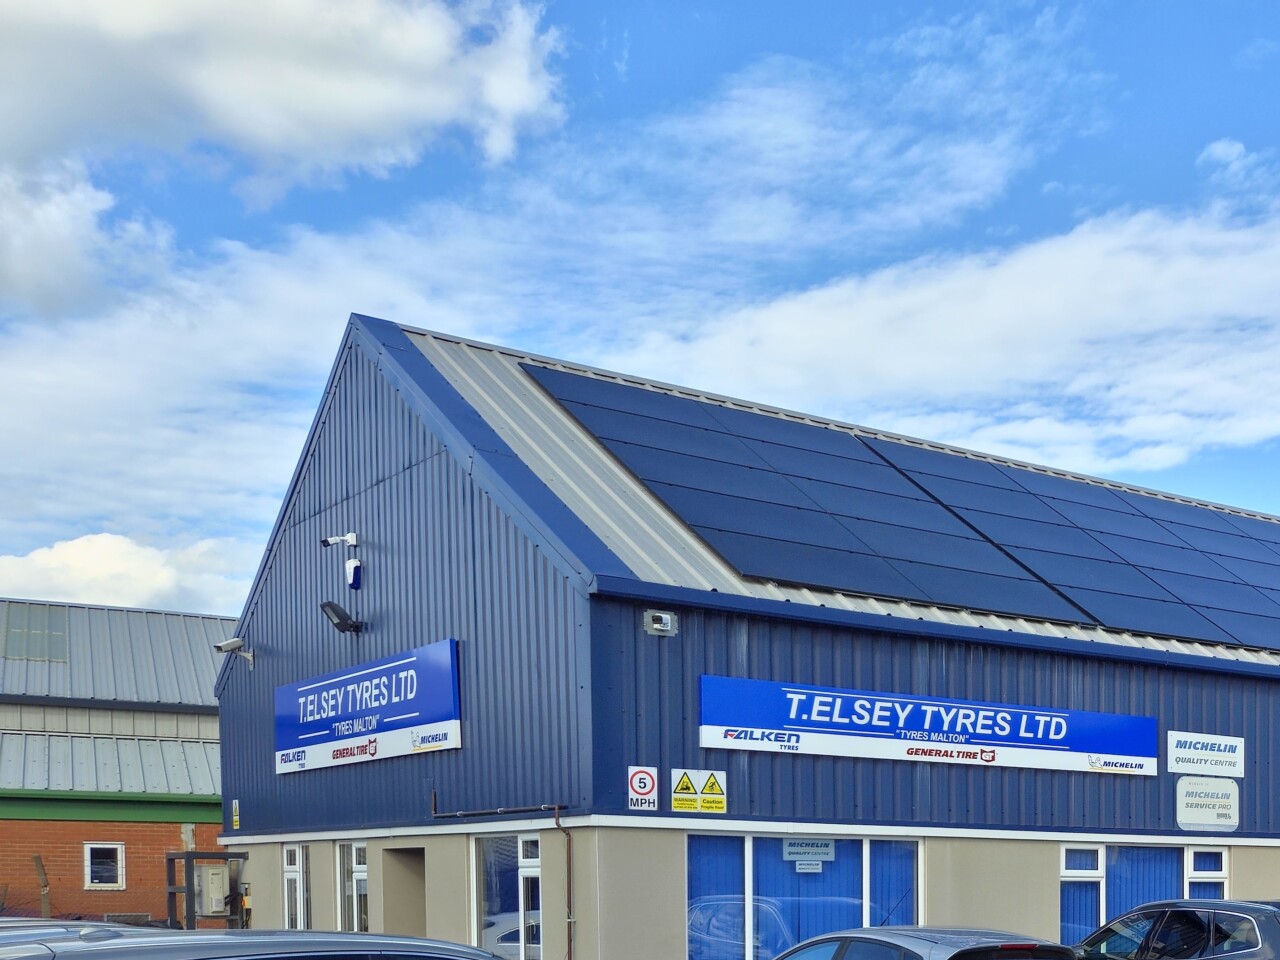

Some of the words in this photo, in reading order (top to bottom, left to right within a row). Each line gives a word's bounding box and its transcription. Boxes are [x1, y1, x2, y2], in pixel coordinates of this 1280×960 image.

[298, 686, 345, 723] T.ELSEY
[347, 675, 389, 713] TYRES
[391, 669, 418, 703] LTD
[786, 693, 914, 728] T.ELSEY
[920, 705, 1012, 736] TYRES
[1019, 714, 1068, 740] LTD
[420, 732, 449, 744] MICHELIN
[722, 729, 801, 744] FALKEN
[896, 729, 929, 741] "TYRES
[930, 732, 970, 744] MALTON"
[332, 746, 356, 760] GENERAL
[356, 744, 368, 756] TIRE
[1175, 739, 1238, 754] MICHELIN
[281, 750, 306, 764] FALKEN
[906, 747, 955, 758] GENERAL
[956, 750, 979, 760] TIRE
[1102, 760, 1145, 770] MICHELIN
[1175, 756, 1209, 765] QUALITY
[1209, 759, 1238, 768] CENTRE
[638, 777, 647, 789] 5
[1184, 791, 1231, 800] MICHELIN
[630, 797, 656, 808] MPH
[1217, 803, 1232, 811] PRO
[788, 841, 830, 849] MICHELIN
